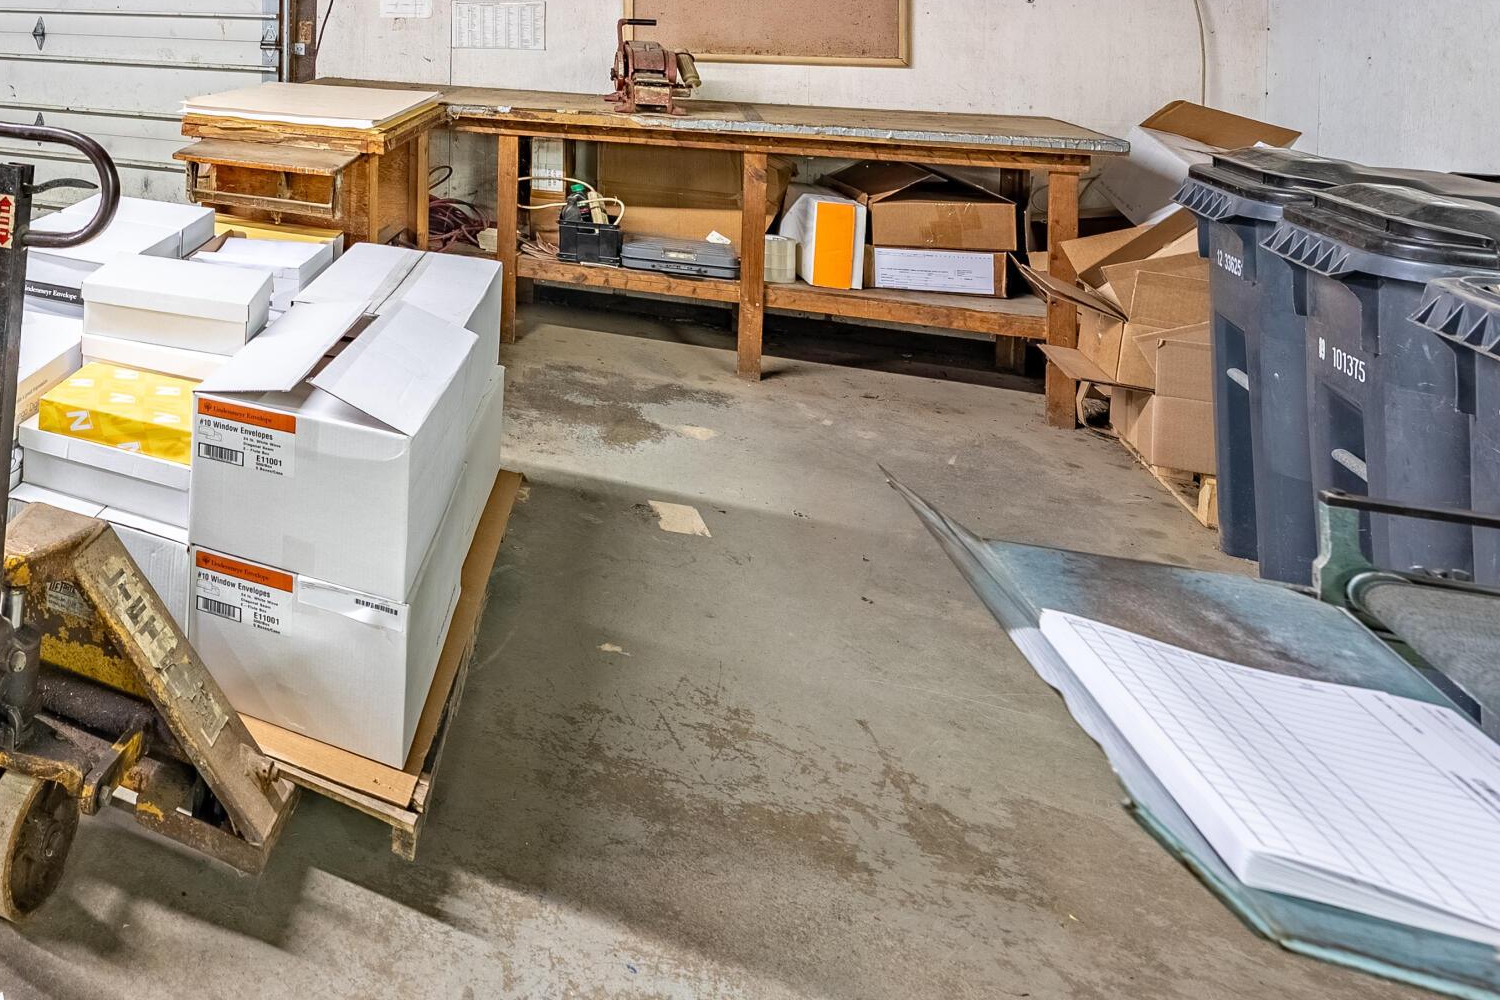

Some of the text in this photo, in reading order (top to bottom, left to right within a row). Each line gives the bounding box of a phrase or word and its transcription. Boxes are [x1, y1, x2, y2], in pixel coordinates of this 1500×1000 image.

[1217, 248, 1223, 268] 12
[25, 284, 77, 300] indenmeyr Envelope
[1332, 346, 1366, 383] 101375
[66, 410, 92, 432] N
[246, 414, 273, 424] Envelope
[200, 418, 273, 440] #10 Window Envelopes
[256, 455, 282, 466] E11001
[244, 568, 268, 581] Envelope
[198, 572, 271, 598] #10 Window Envelopes
[254, 612, 280, 625] E11001
